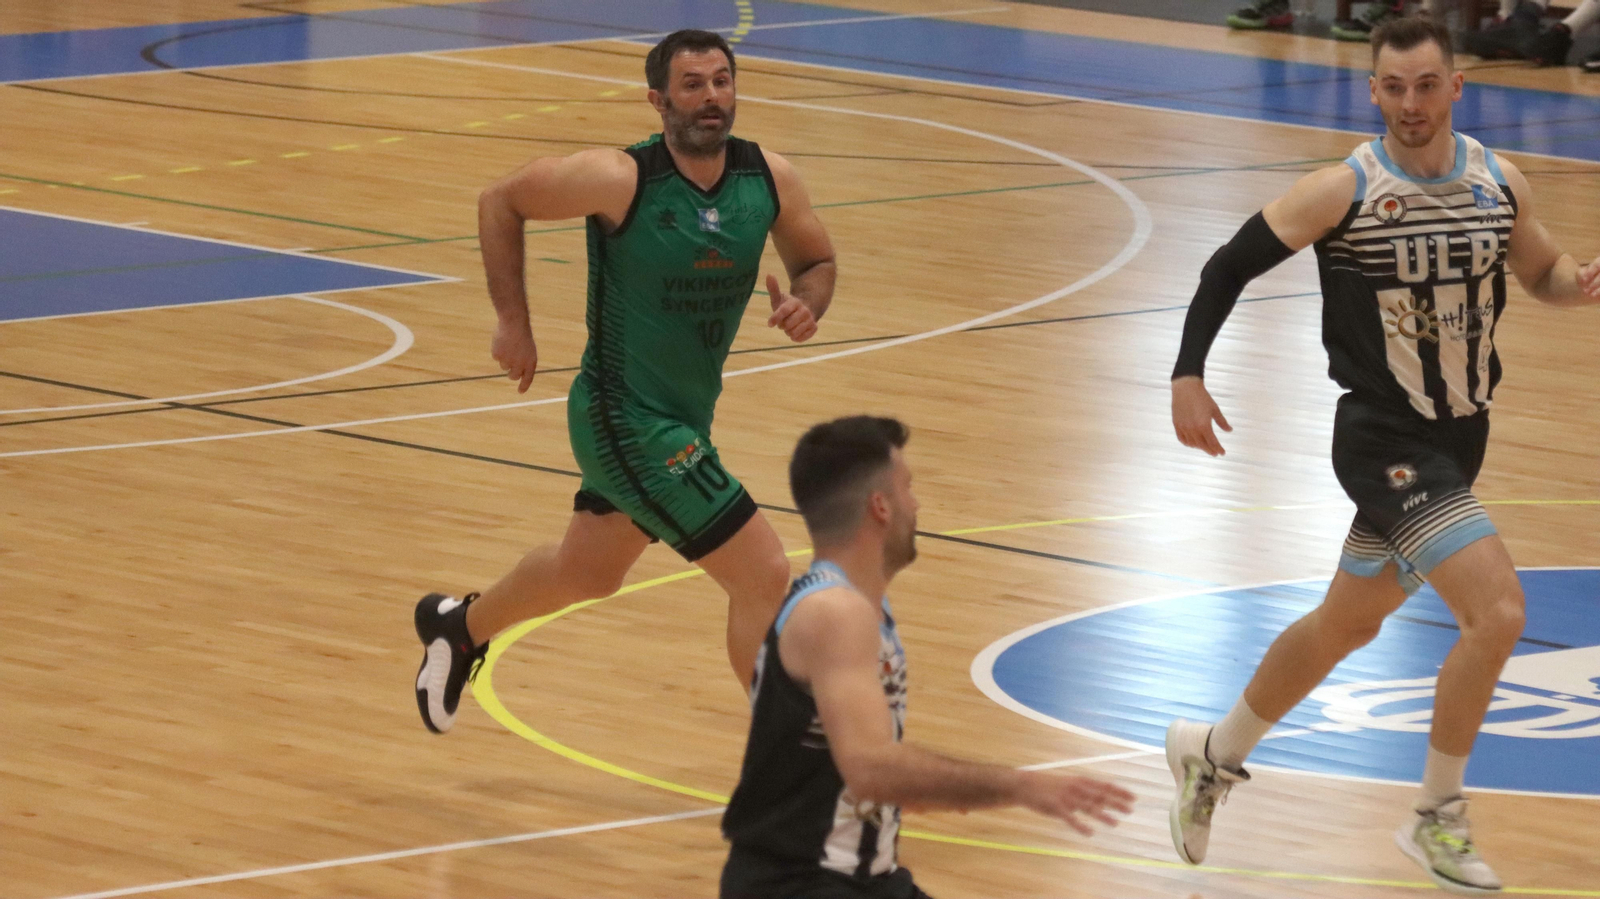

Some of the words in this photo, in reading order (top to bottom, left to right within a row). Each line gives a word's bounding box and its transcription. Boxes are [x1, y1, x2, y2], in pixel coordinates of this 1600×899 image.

[1477, 200, 1495, 208] EBA
[1390, 231, 1499, 283] ULB
[698, 318, 724, 349] 10
[682, 455, 730, 504] 10
